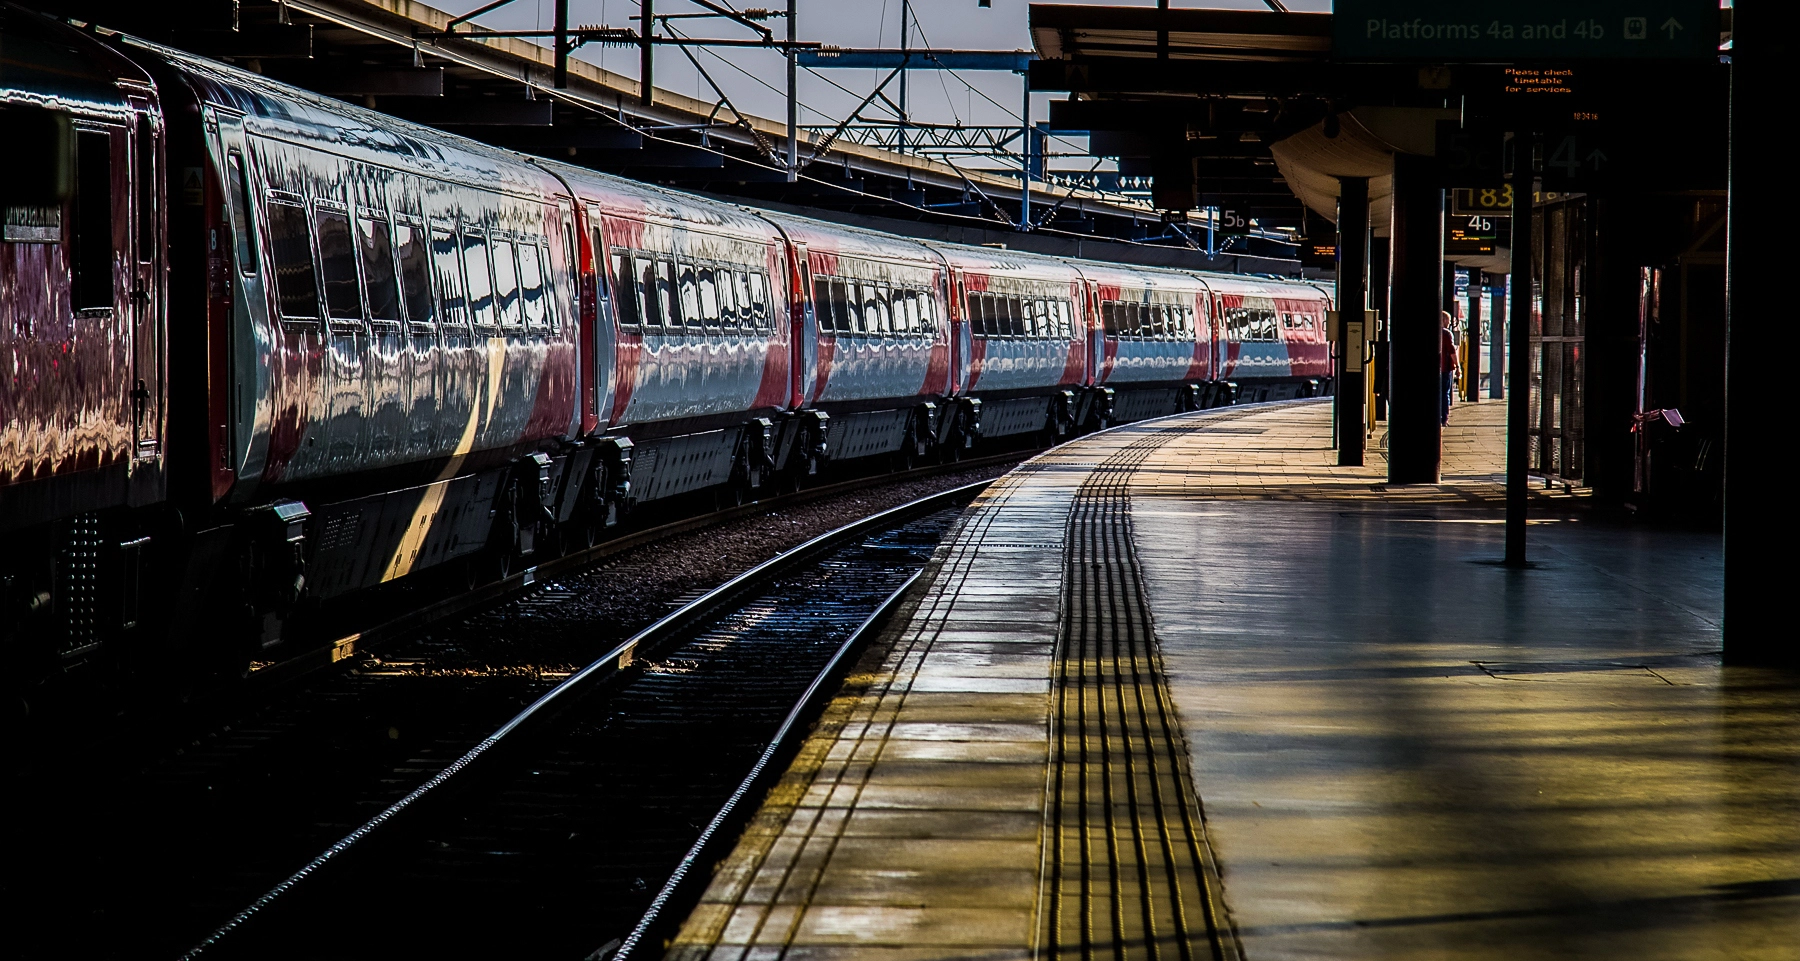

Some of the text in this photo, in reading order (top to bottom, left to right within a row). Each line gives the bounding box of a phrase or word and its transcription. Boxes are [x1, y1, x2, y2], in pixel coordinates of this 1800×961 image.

[1367, 18, 1605, 40] Platforms 4a and 4b
[1505, 68, 1540, 76] Please
[1548, 135, 1581, 179] 4
[1224, 210, 1244, 227] 5b
[1468, 215, 1491, 231] 4b
[210, 228, 218, 251] B
